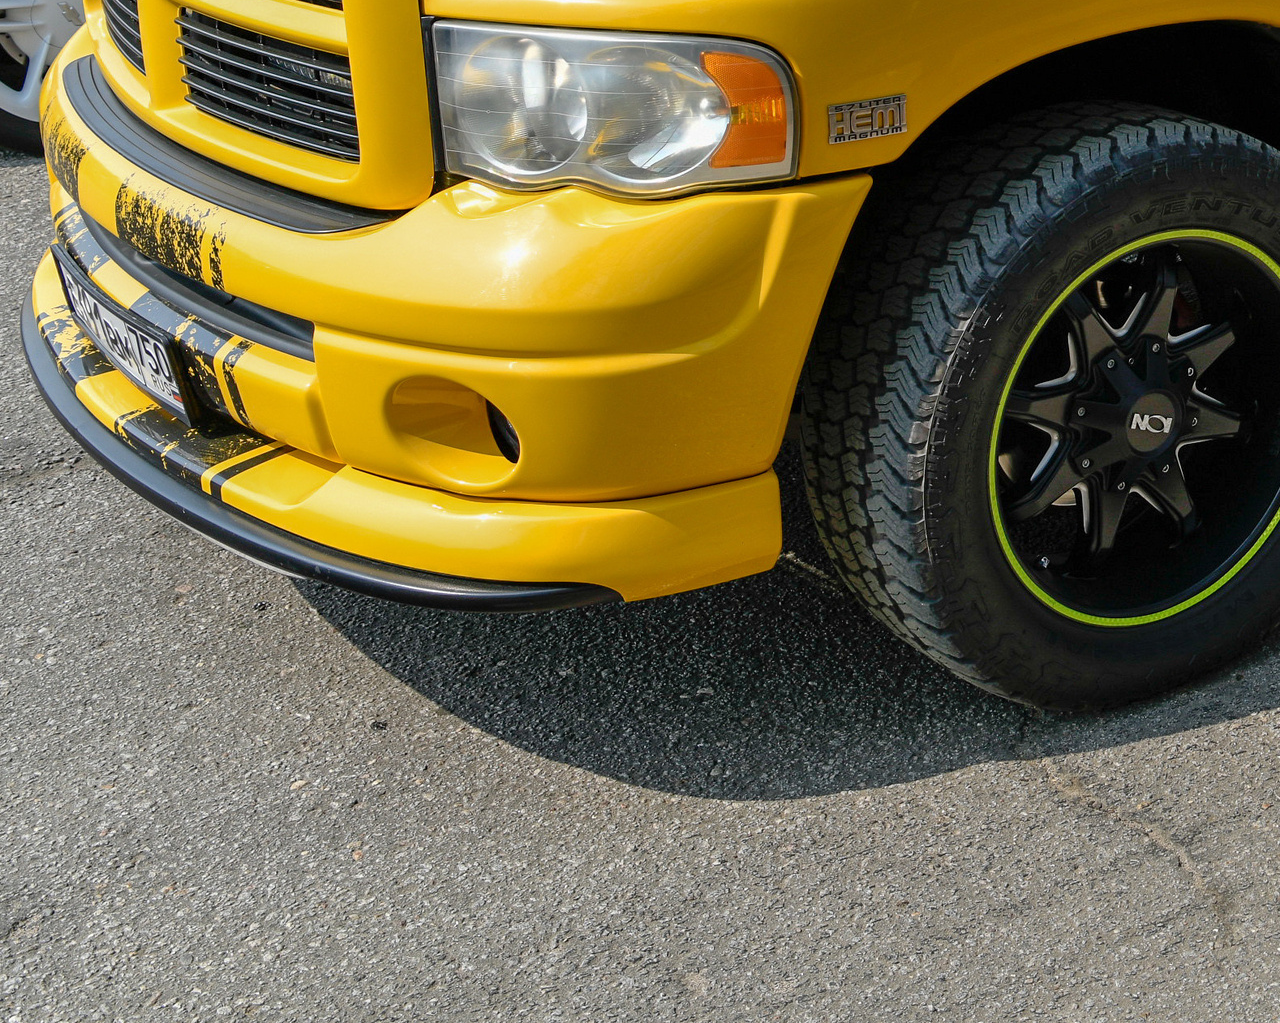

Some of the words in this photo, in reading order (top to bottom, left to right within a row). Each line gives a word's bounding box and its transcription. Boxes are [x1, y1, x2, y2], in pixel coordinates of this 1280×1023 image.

[859, 97, 901, 109] LITER
[828, 101, 907, 136] HEMI
[834, 126, 902, 142] MAGNUM
[126, 324, 174, 383] 750
[150, 374, 174, 397] RUS
